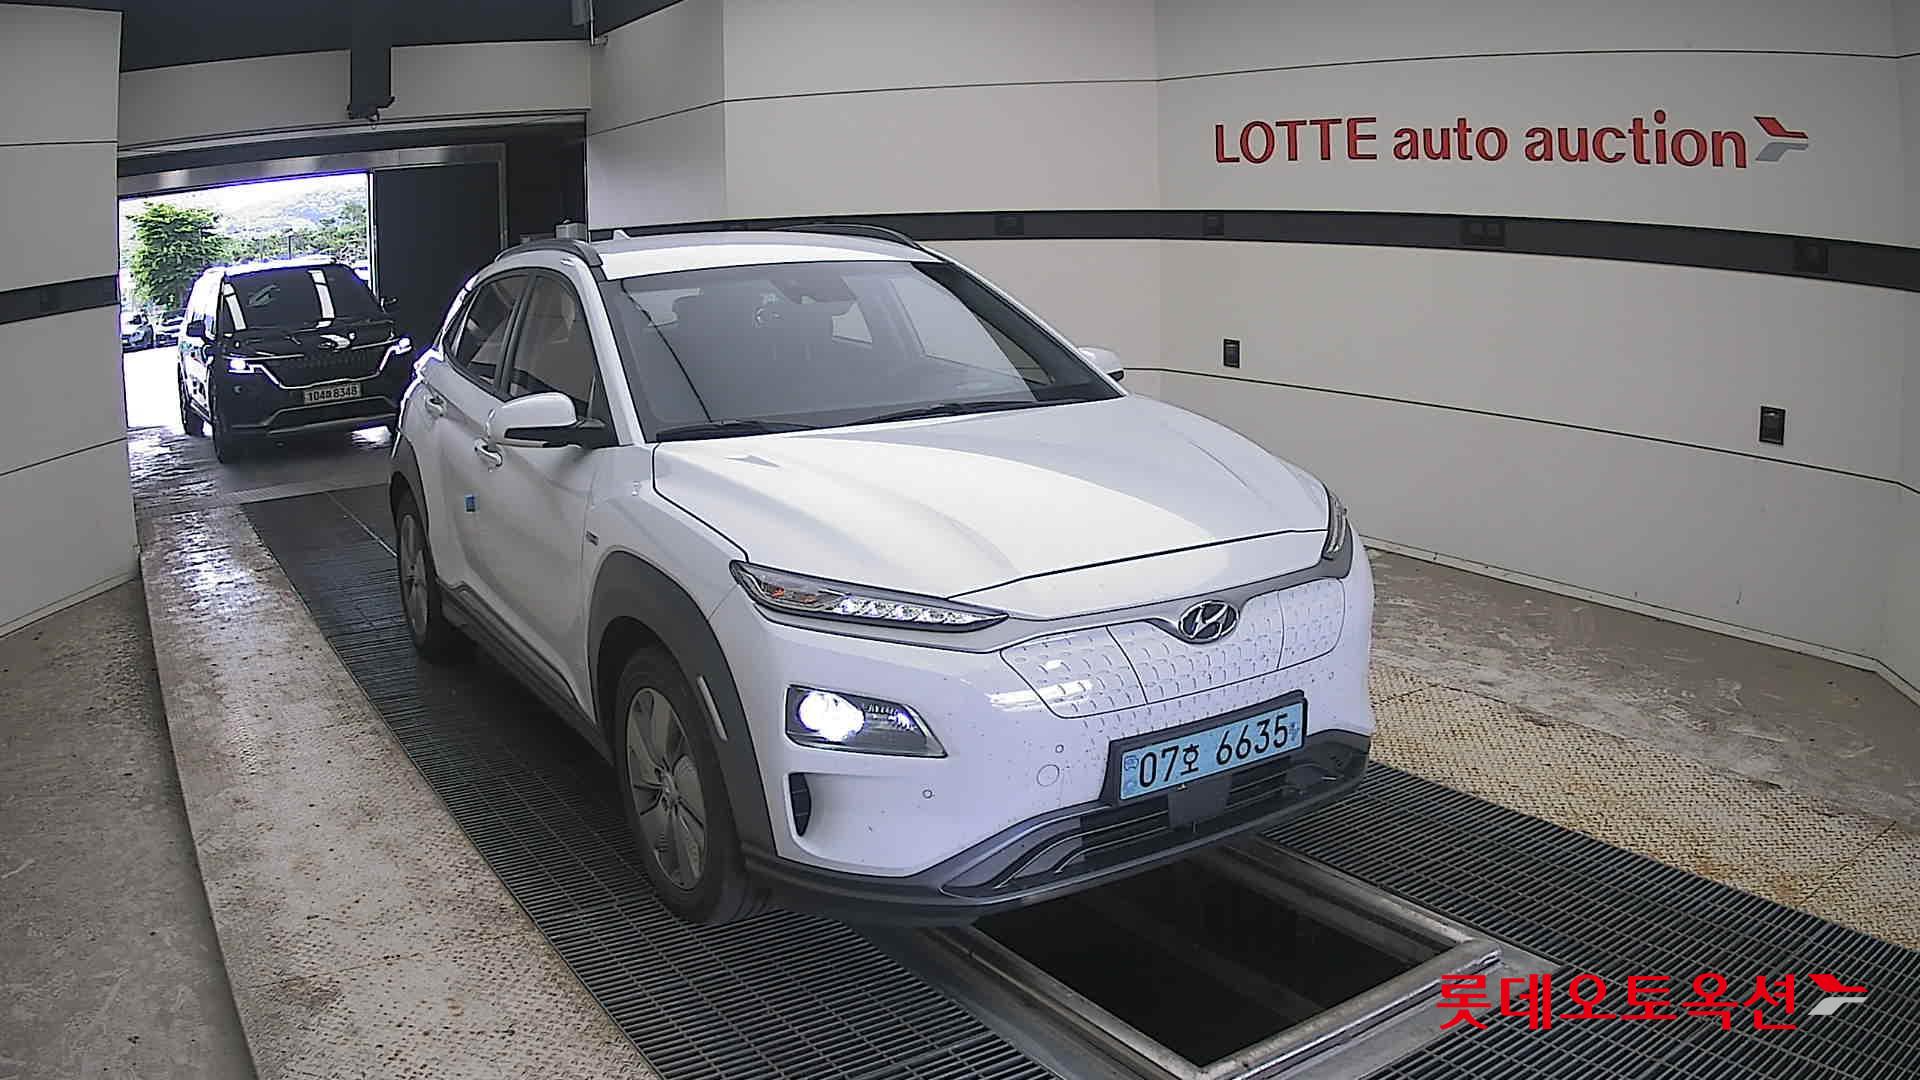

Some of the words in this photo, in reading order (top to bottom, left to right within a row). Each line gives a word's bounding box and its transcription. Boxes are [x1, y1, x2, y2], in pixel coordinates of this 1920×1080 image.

[1215, 116, 1378, 164] LOTTE
[1393, 117, 1508, 162] auto
[1524, 109, 1747, 168] auction
[1139, 743, 1200, 788] 07호
[1216, 713, 1288, 766] 6635
